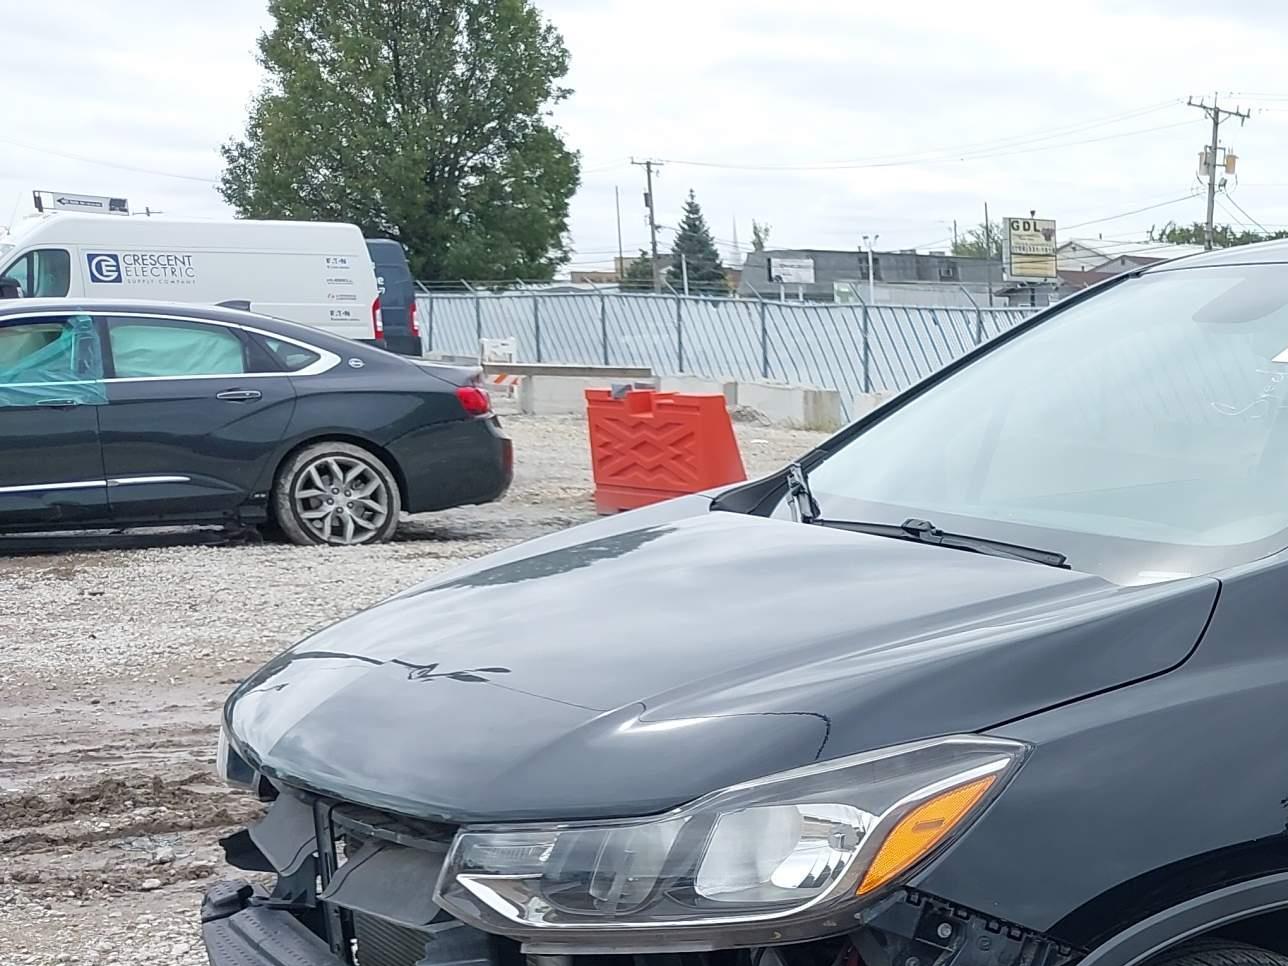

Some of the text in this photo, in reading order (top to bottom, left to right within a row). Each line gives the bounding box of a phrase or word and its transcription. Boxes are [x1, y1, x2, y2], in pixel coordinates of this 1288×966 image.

[1011, 220, 1041, 232] GDL
[122, 254, 193, 266] CRESCENT
[125, 266, 195, 278] ELECTRIC
